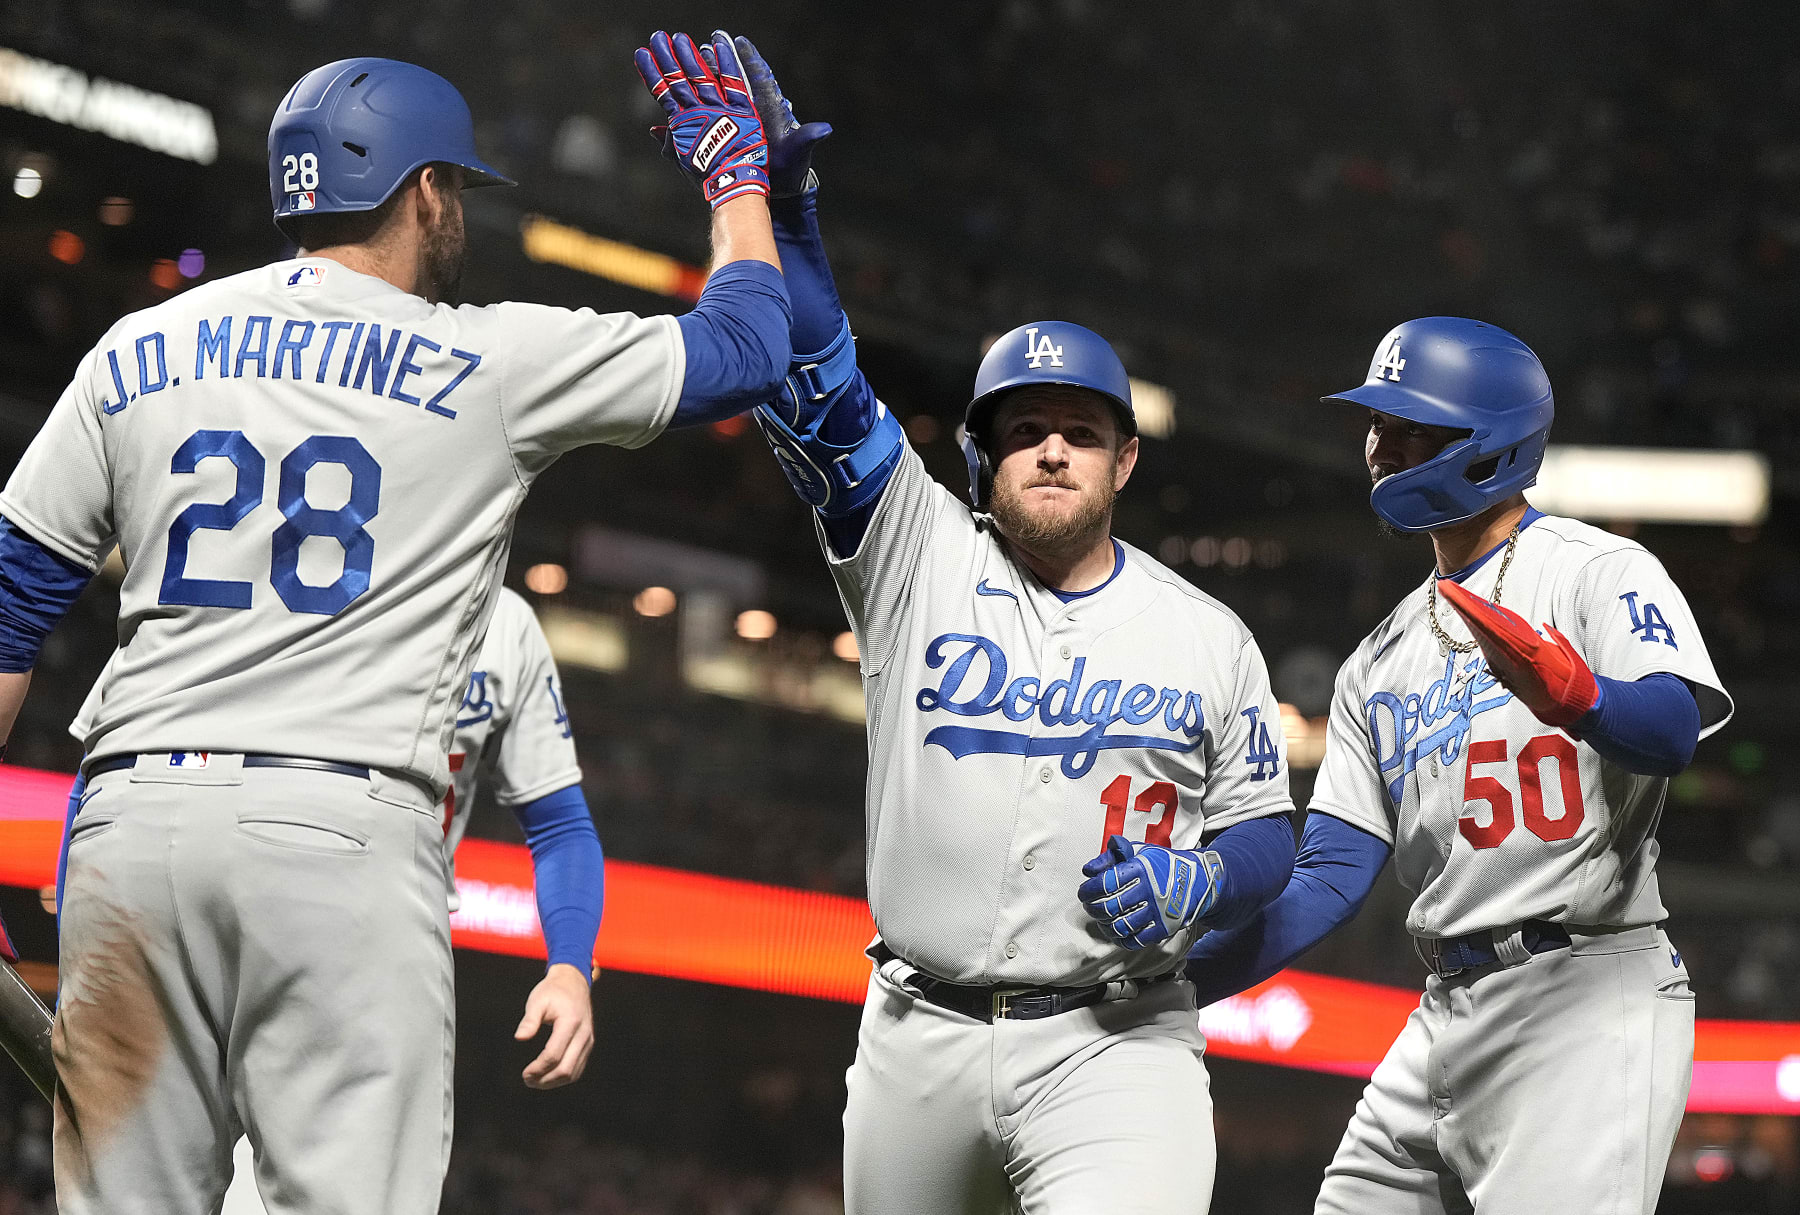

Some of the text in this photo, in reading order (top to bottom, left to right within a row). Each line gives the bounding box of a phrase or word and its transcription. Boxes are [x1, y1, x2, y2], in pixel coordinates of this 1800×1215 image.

[282, 152, 320, 193] 28
[103, 315, 481, 419] J.D. MARTINEZ
[1024, 327, 1064, 369] LA
[1375, 333, 1407, 383] LA
[158, 430, 382, 615] 28
[1619, 591, 1679, 652] LA
[916, 632, 1205, 780] Dodgers
[1240, 706, 1280, 782] LA
[1365, 649, 1502, 774] Dodge
[1458, 734, 1585, 850] 50
